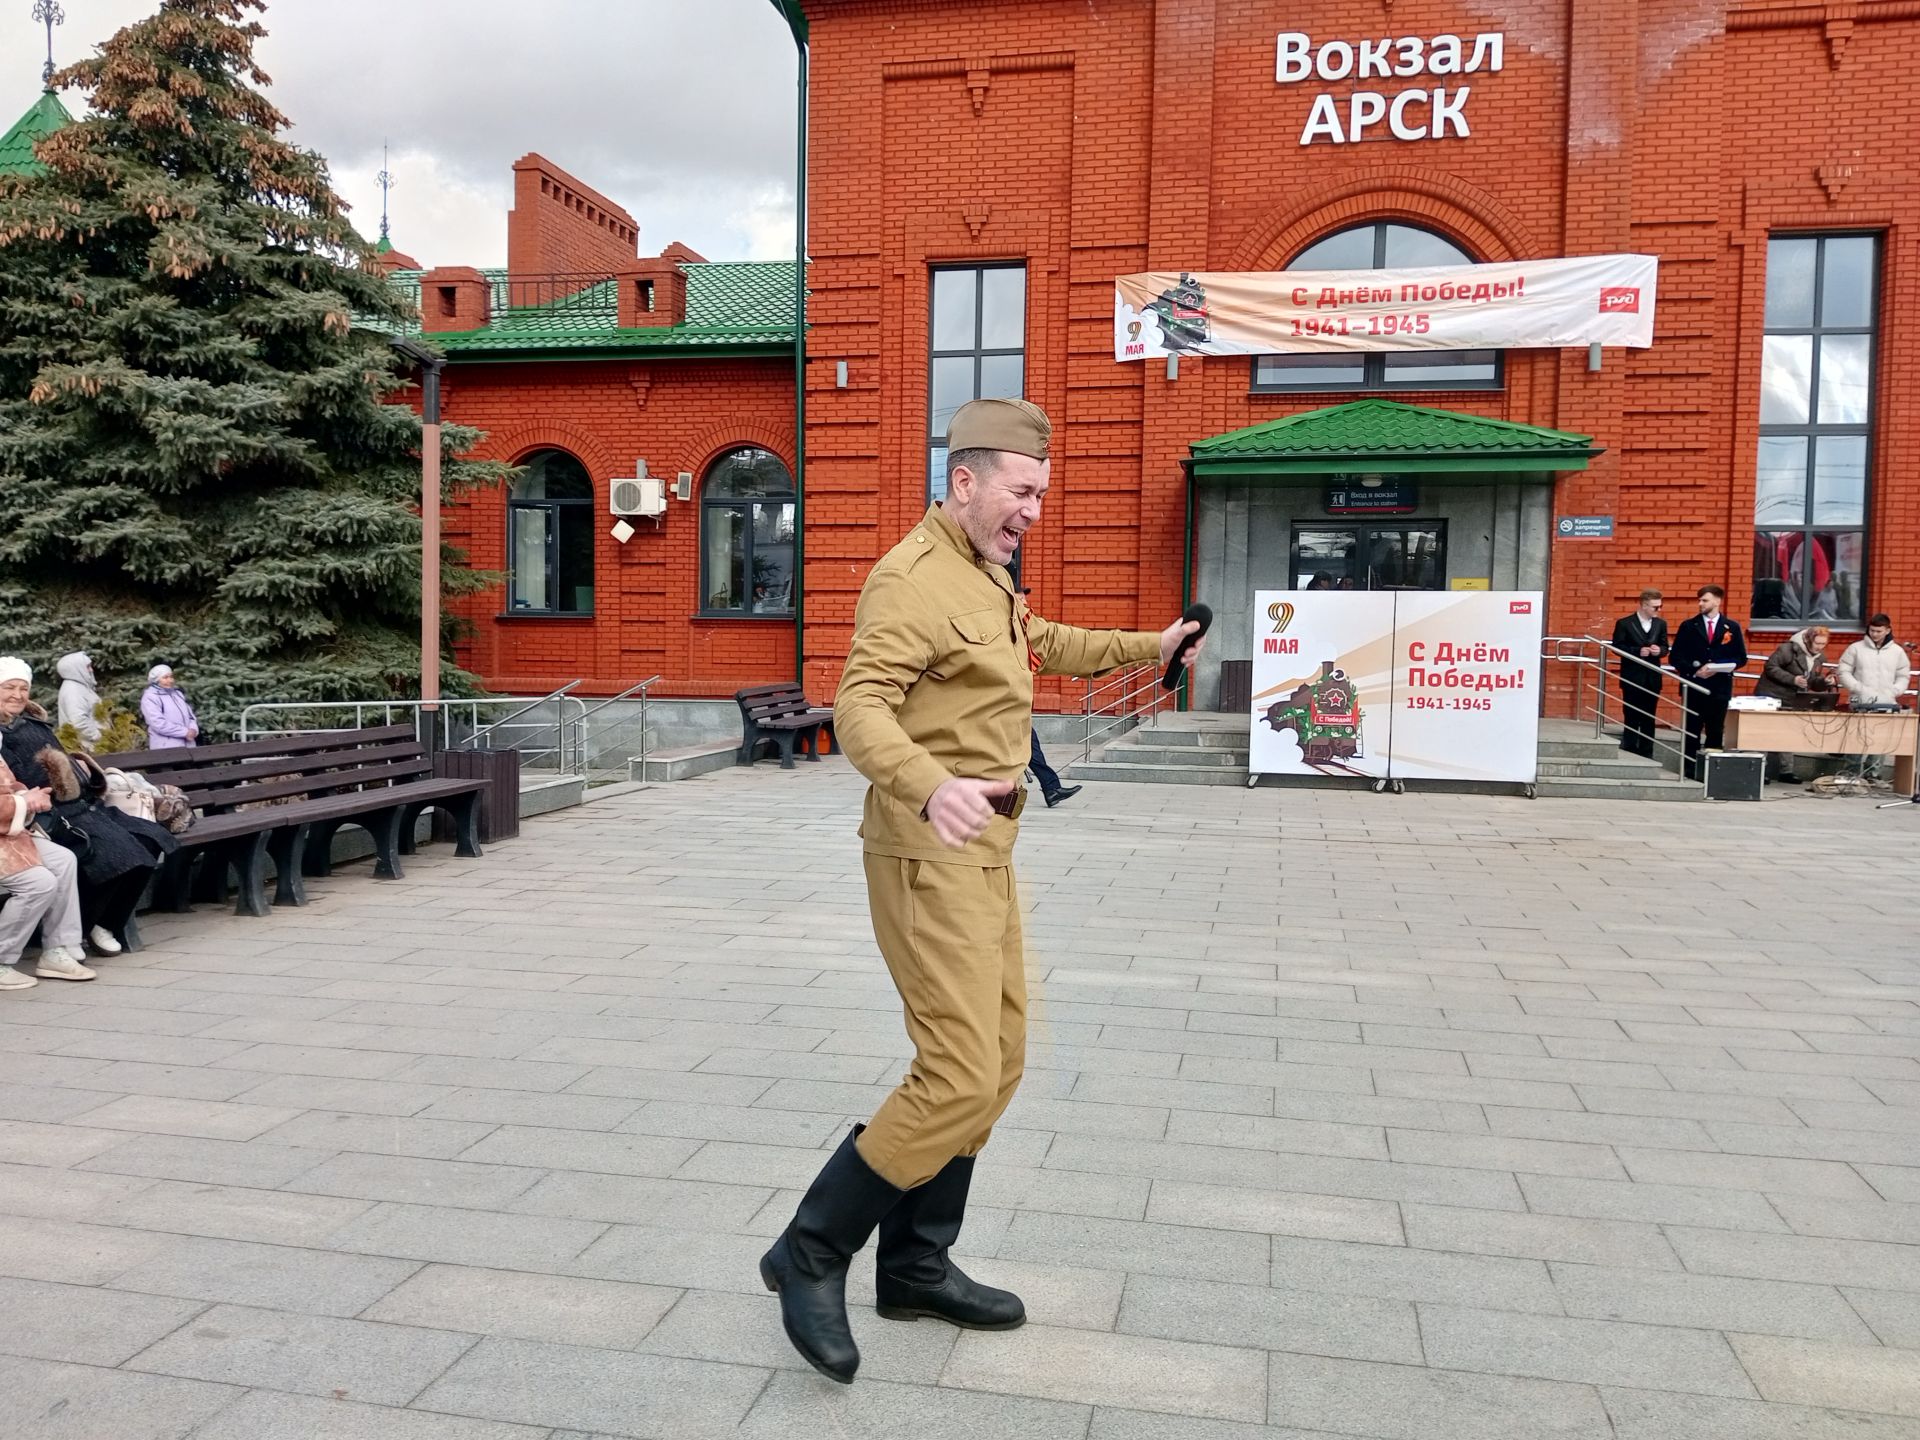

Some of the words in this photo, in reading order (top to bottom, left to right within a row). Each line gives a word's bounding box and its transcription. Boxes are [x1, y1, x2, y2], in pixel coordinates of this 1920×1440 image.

[1275, 32, 1504, 83] Вокзал
[1300, 86, 1471, 146] АРСК
[1292, 288, 1308, 306] С
[1316, 287, 1392, 309] Днём
[1400, 276, 1525, 303] Победы!
[1127, 321, 1142, 342] 9
[1125, 343, 1145, 356] МАЯ
[1267, 602, 1294, 634] 9
[1263, 638, 1299, 654] МАЯ
[1408, 641, 1426, 662] С
[1433, 642, 1510, 666] Днём
[1408, 667, 1525, 692] Победы!
[1407, 697, 1492, 711] 1941-1945
